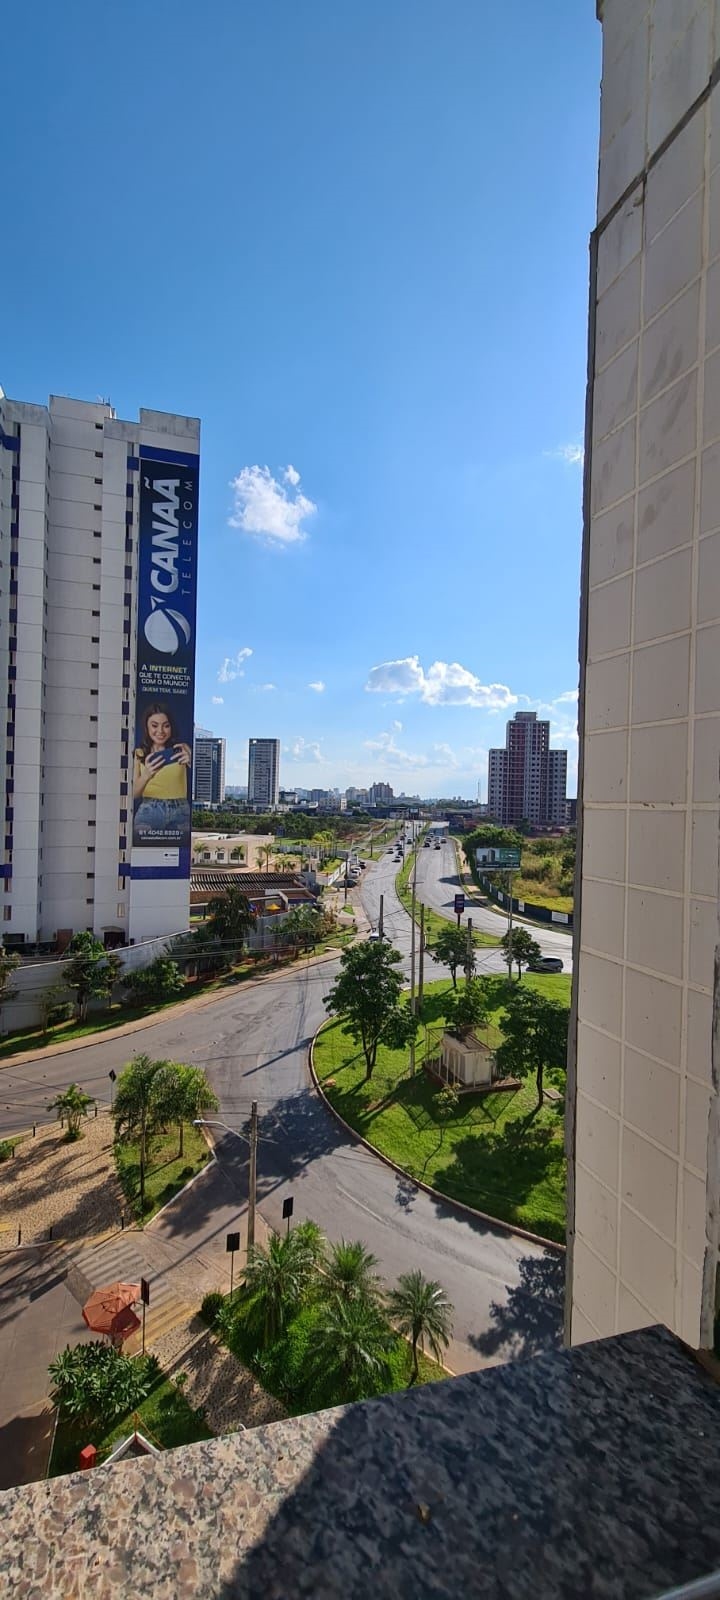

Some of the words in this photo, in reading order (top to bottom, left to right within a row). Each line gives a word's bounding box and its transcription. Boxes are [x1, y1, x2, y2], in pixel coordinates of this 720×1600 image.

[144, 476, 180, 593] CANAÃ
[182, 480, 193, 596] TELECOM
[150, 665, 187, 674] INTERNET
